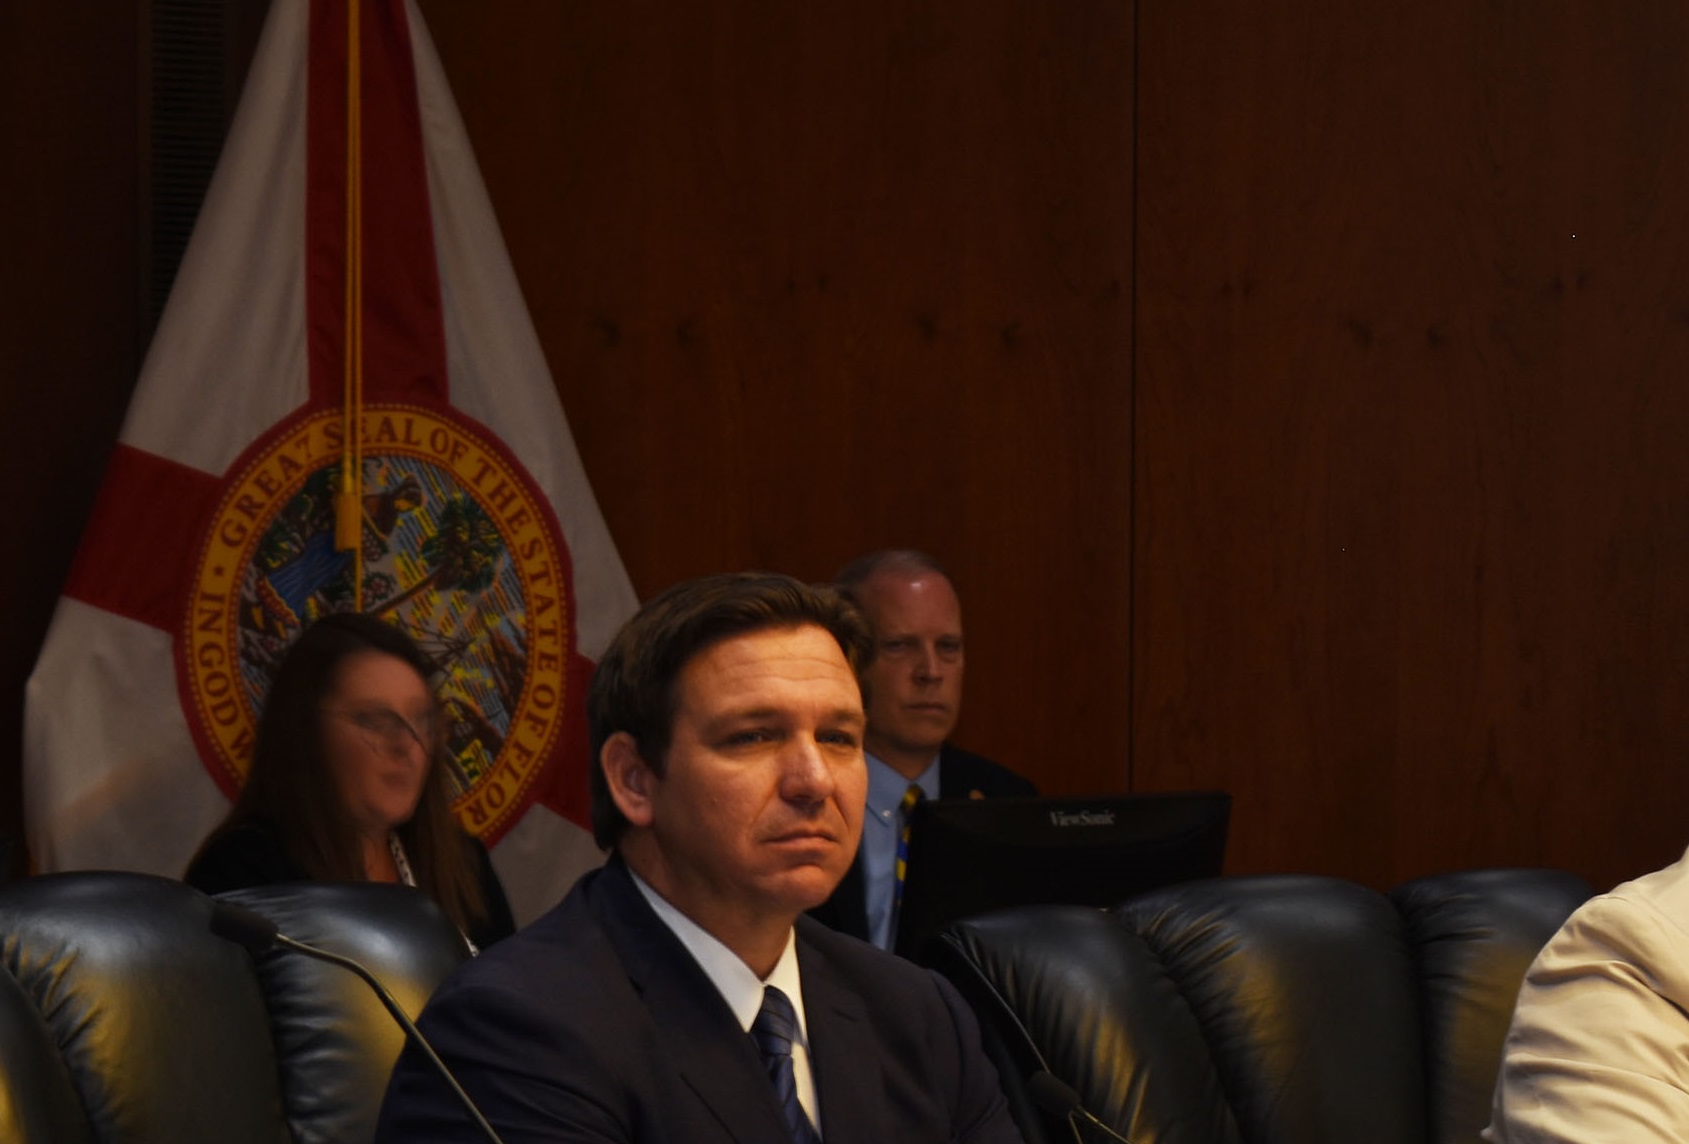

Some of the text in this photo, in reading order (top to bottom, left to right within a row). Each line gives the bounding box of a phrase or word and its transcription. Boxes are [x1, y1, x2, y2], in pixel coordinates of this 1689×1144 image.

[429, 427, 470, 463] OF
[472, 457, 533, 537] THE
[198, 591, 225, 636] IN
[521, 537, 560, 673] STATE
[198, 642, 239, 726] GOD
[525, 683, 555, 738] OF
[468, 741, 534, 825] FLOR
[1050, 809, 1115, 827] ViewSonic
